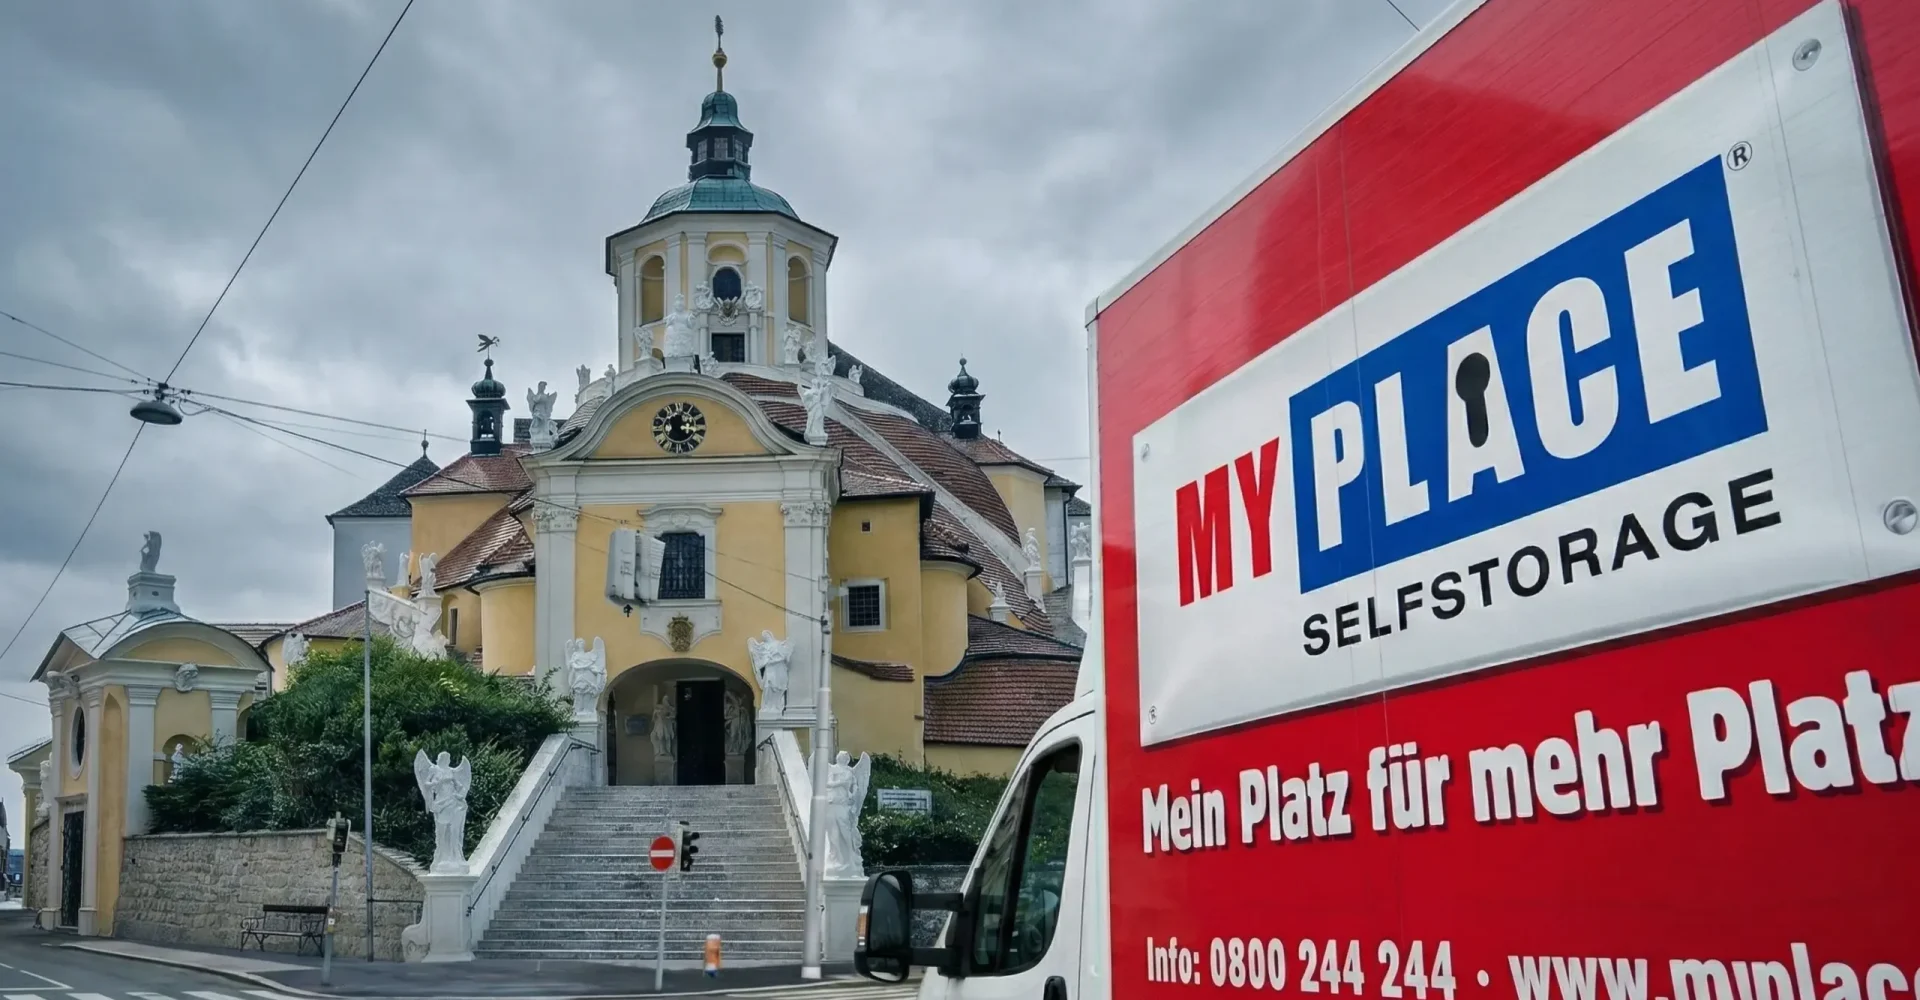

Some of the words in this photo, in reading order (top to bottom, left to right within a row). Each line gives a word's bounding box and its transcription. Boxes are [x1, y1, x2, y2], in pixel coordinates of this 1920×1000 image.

[1177, 438, 1279, 606] MY
[1311, 218, 1722, 553] PLACE
[1303, 468, 1782, 656] SELFSTORAGE
[1142, 778, 1226, 854] Mein
[1239, 762, 1352, 844] Platz
[1366, 741, 1450, 831] für
[1468, 710, 1663, 822] mehr
[1147, 936, 1201, 985] Info:
[1209, 937, 1286, 991] 0800
[1298, 939, 1365, 995] 244
[1378, 939, 1457, 1000] 244
